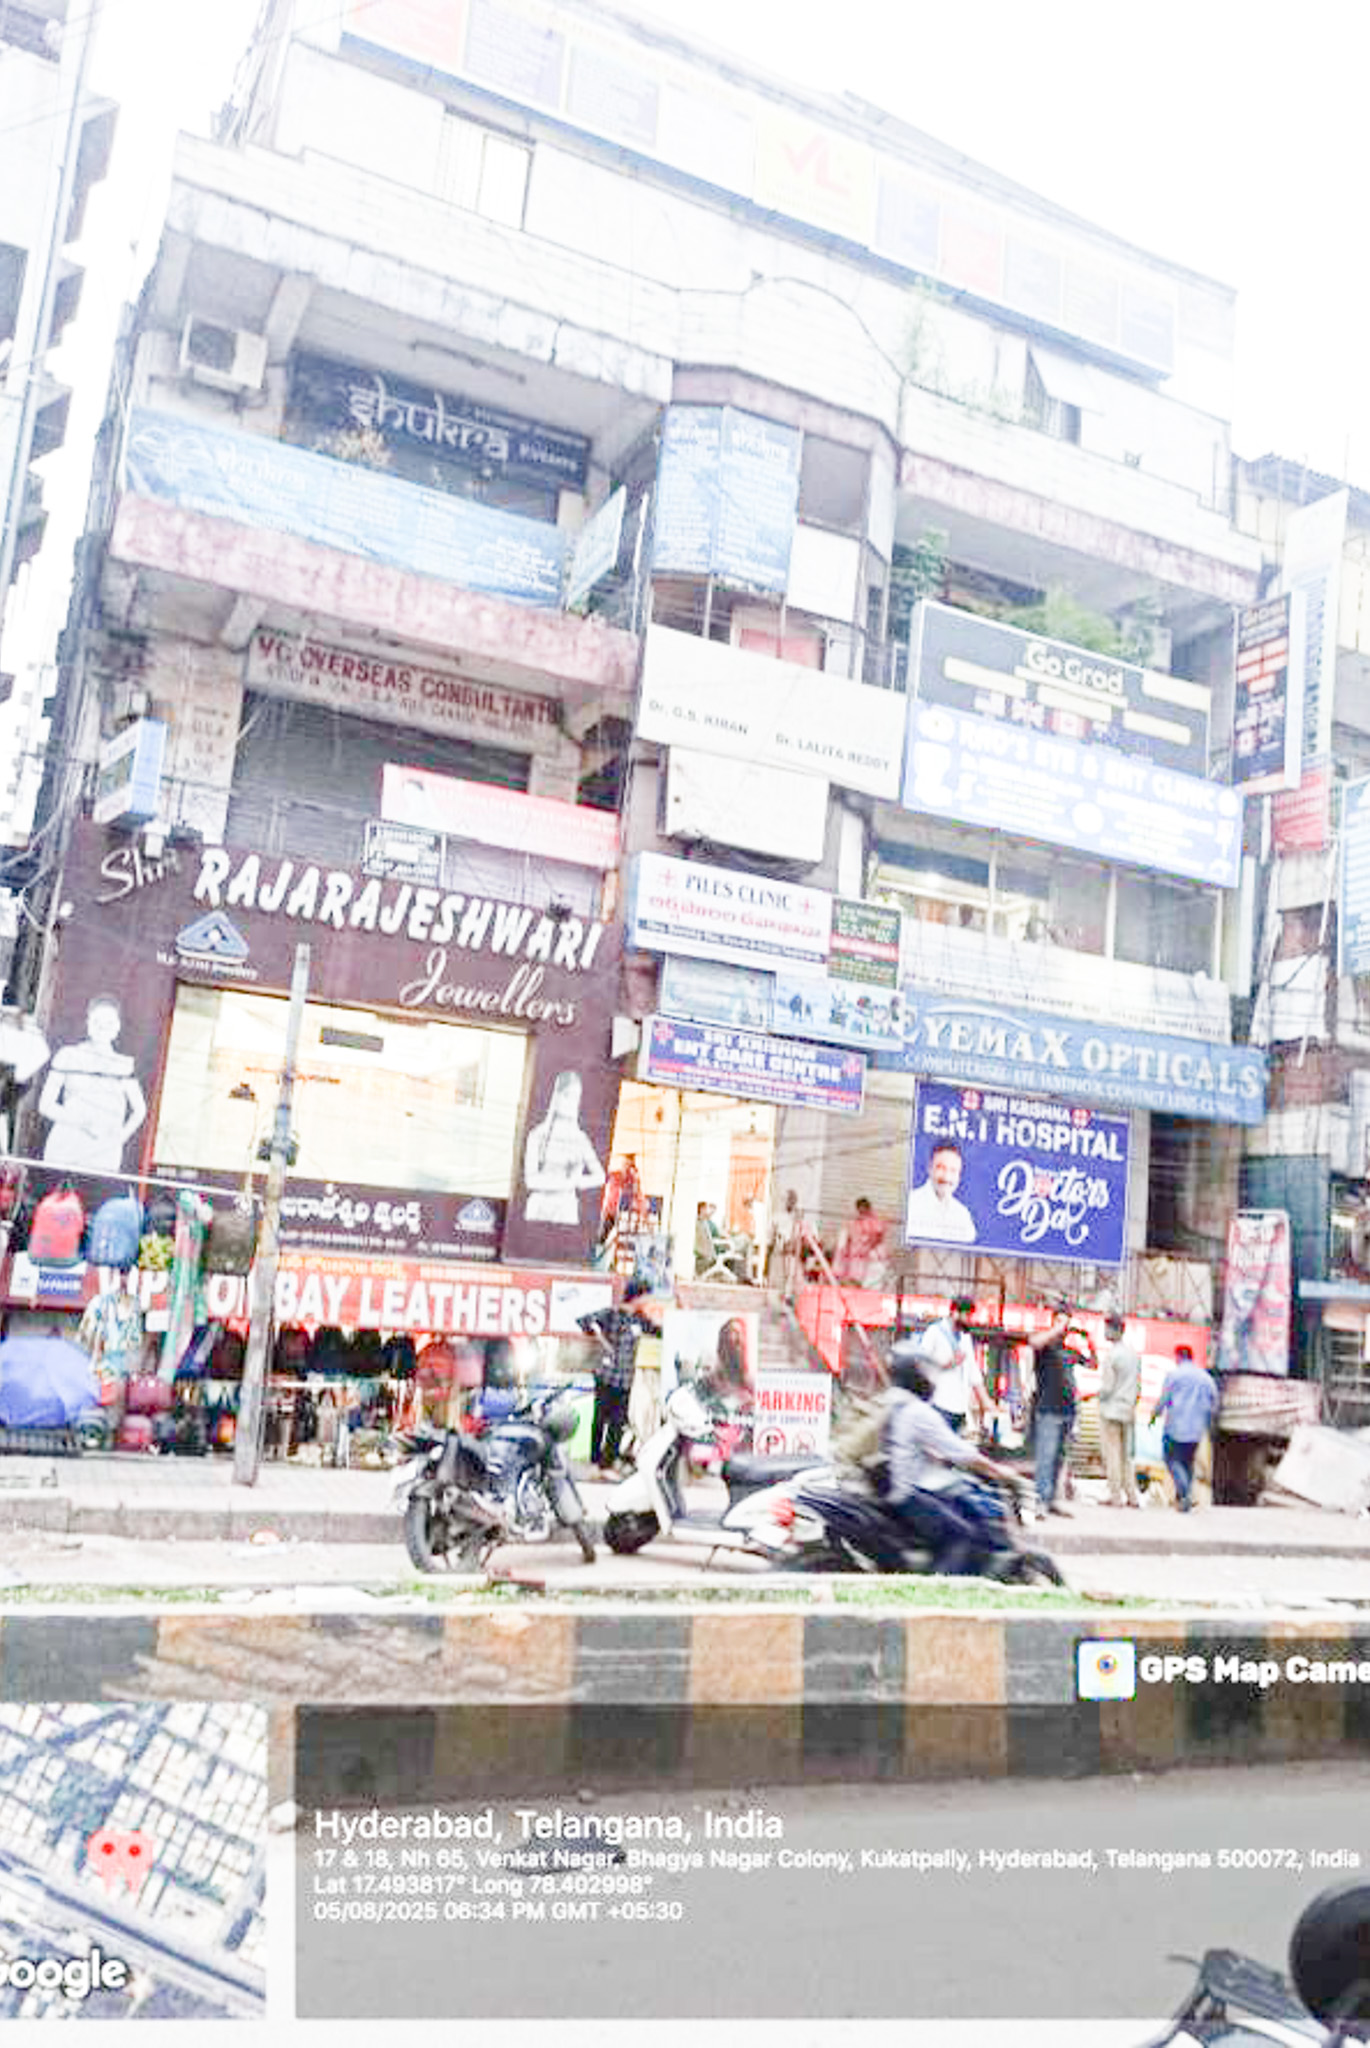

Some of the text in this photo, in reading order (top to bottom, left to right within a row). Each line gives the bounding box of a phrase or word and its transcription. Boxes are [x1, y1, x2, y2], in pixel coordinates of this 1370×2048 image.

[194, 848, 604, 968] RAJARAJESHWARI
[684, 873, 734, 899] PILES
[400, 946, 576, 1026] Jewellers
[1081, 1038, 1261, 1100] OPTICALS
[996, 1116, 1124, 1161] HOSPITAL
[359, 1277, 546, 1334] LEATHERS
